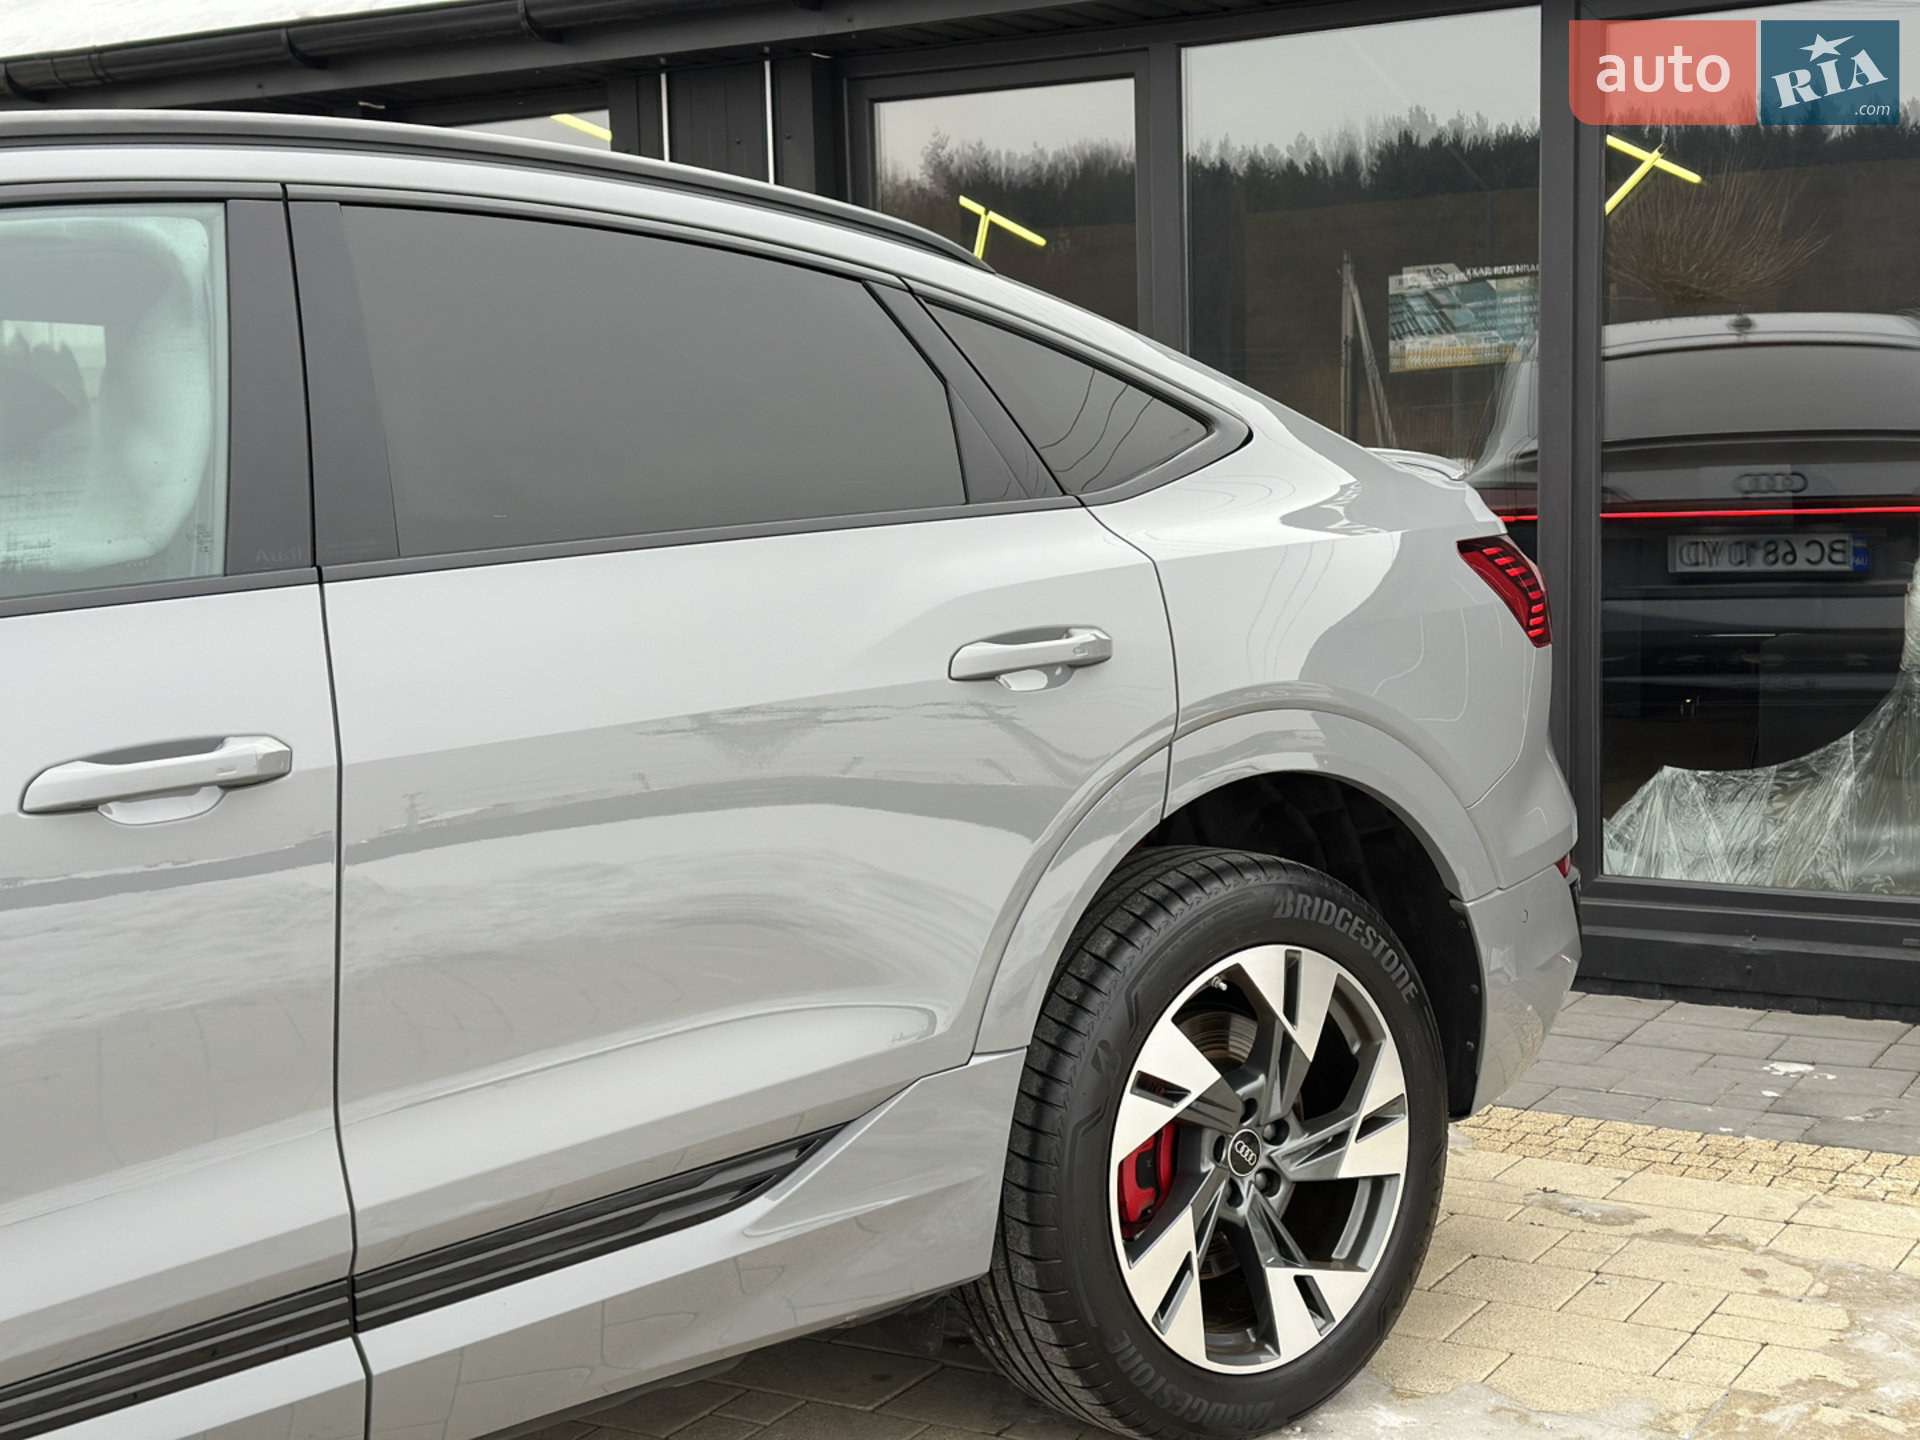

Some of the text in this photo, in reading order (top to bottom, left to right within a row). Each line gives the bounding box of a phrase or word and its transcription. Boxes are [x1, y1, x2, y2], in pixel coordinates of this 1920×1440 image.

[256, 547, 302, 562] Audi
[1272, 887, 1419, 1004] BRIDGESTONE
[1104, 1329, 1276, 1431] BRIDGESTONE
